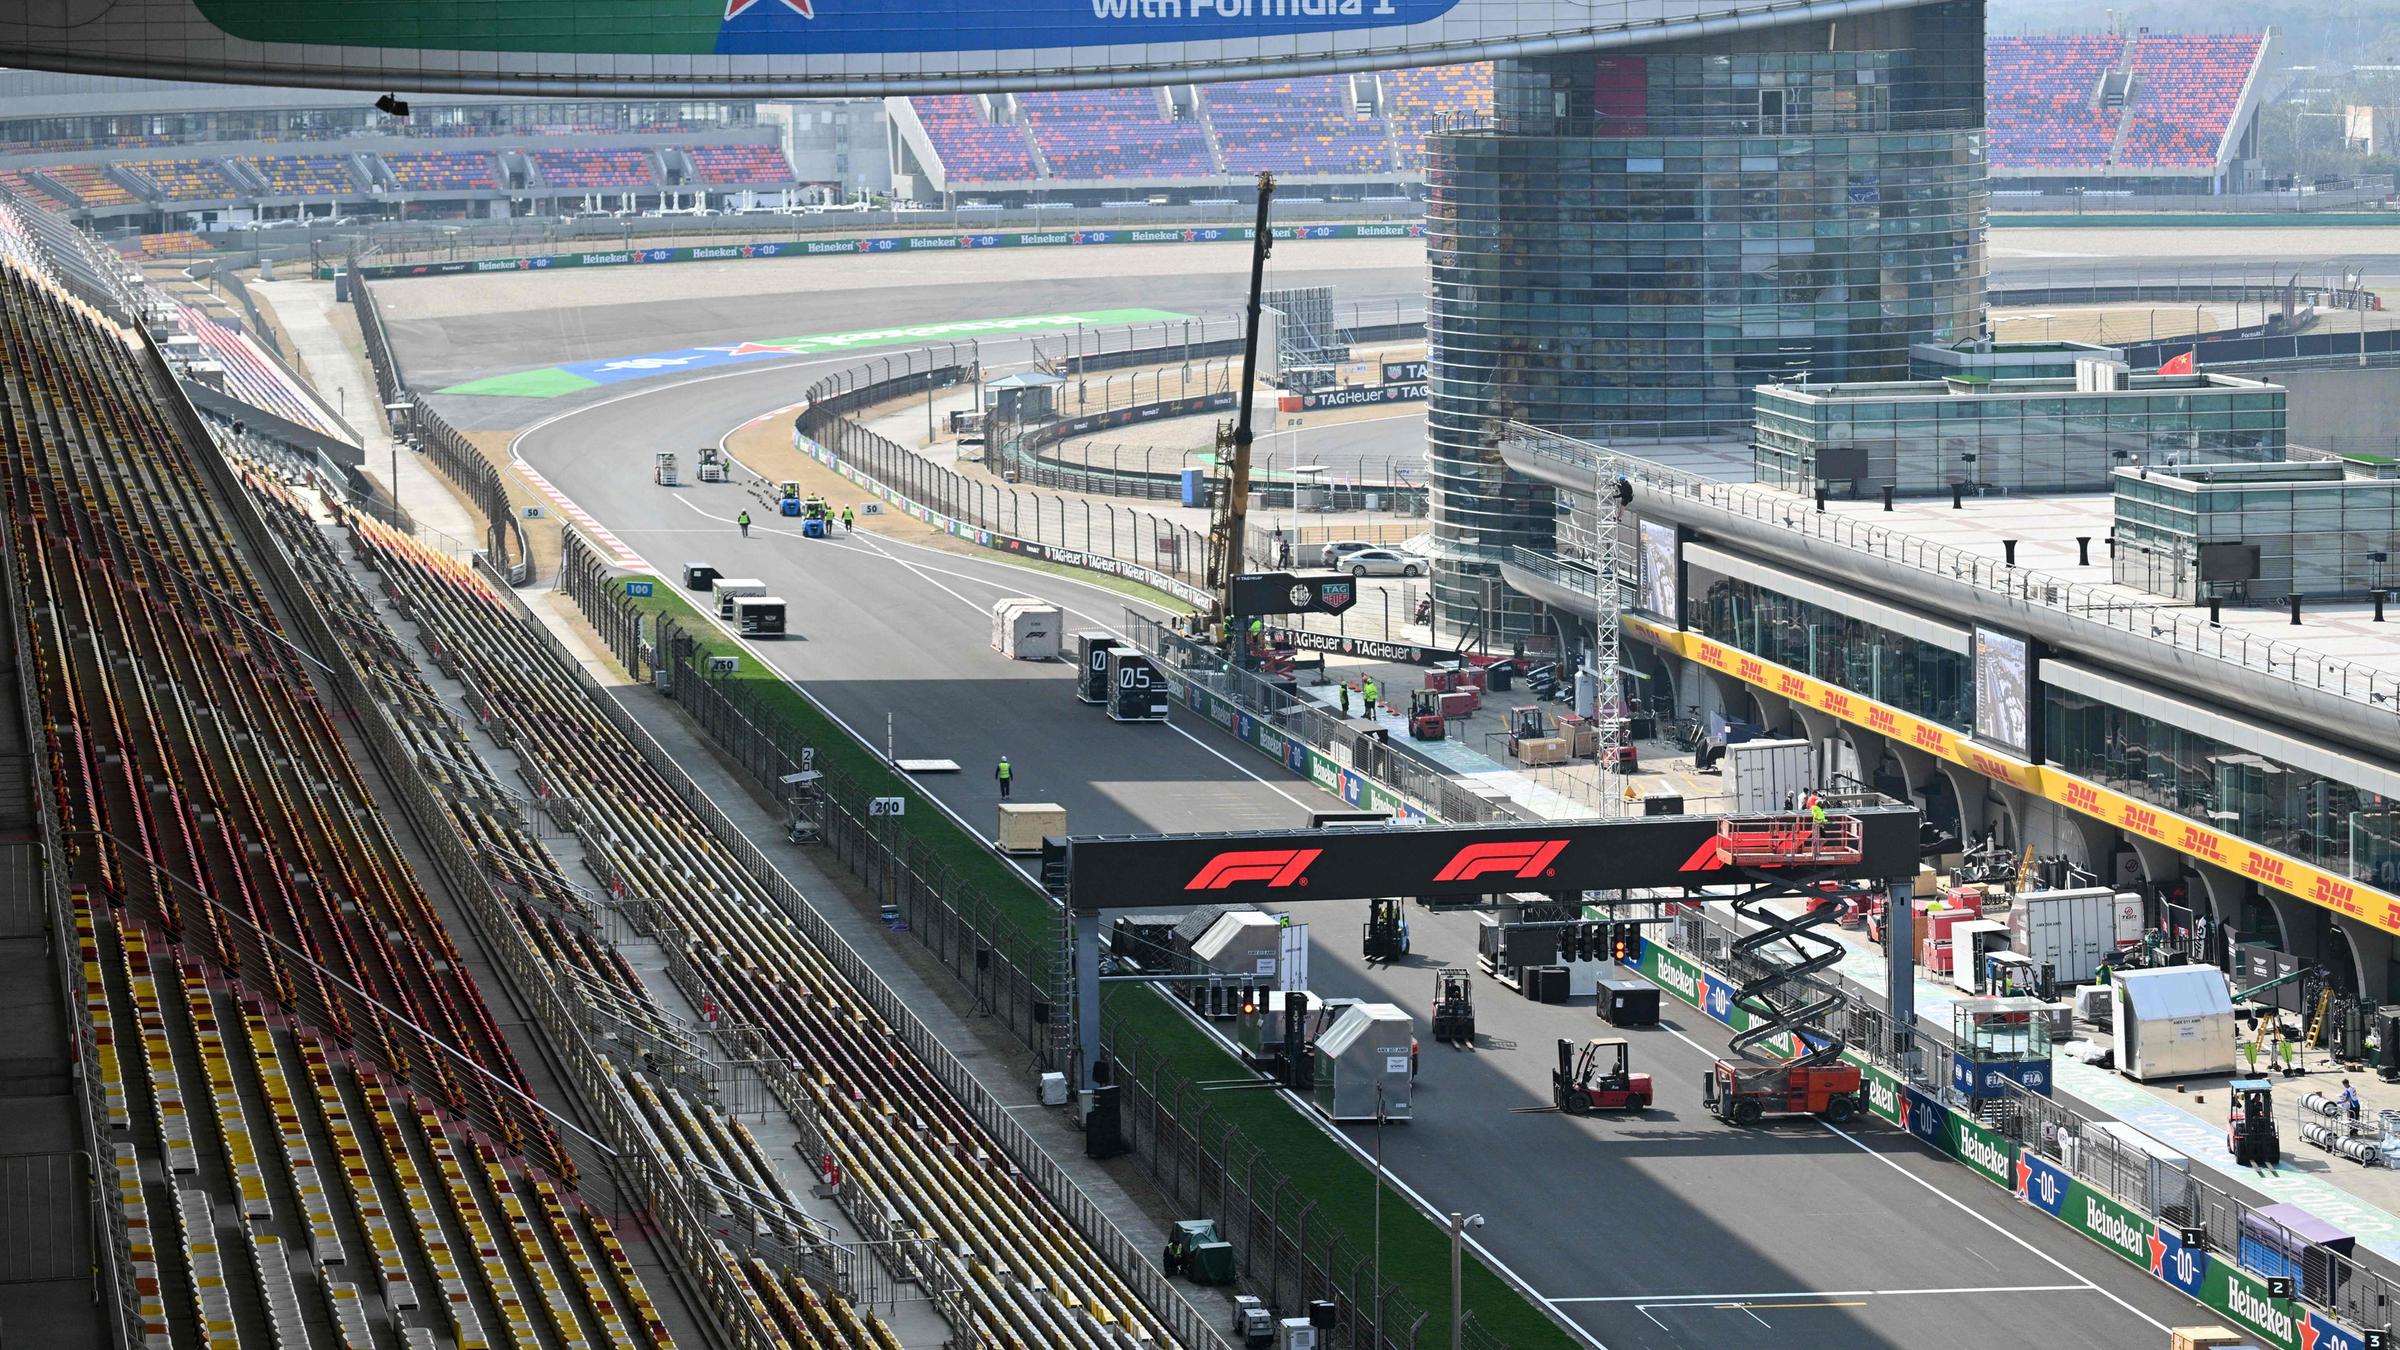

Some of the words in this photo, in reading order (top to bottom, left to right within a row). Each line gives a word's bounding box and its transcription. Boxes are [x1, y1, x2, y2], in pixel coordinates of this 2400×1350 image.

[1132, 230, 1178, 241] Heineken
[1244, 226, 1291, 238] Heken
[1357, 225, 1403, 236] Heineken
[910, 237, 956, 248] Heineken
[1021, 232, 1067, 245] Heineken
[693, 247, 737, 258] Heineken
[808, 242, 854, 253] Heineken
[582, 251, 628, 265] Heineken
[479, 261, 515, 271] Heineken
[527, 508, 539, 517] 50
[866, 504, 878, 514] 50
[630, 584, 649, 595] 100
[1325, 585, 1347, 593] TAG
[1355, 641, 1409, 660] TAGHeuer
[1700, 642, 1725, 668] DHL
[1740, 658, 1764, 684] DHL
[1781, 673, 1806, 700] DHL
[1824, 690, 1850, 717] DHL
[1869, 706, 1896, 734] DHL
[1916, 724, 1944, 753] DHL
[1312, 756, 1337, 789] Heineken
[2067, 782, 2100, 815] DHL
[875, 801, 900, 813] 200
[2124, 804, 2158, 836] DHL
[2184, 826, 2220, 861] DHL
[2248, 850, 2286, 886] DHL
[2316, 876, 2356, 913] DHL
[1657, 953, 1696, 998] Heineken
[1715, 986, 1726, 1016] 0.0
[1987, 1077, 2005, 1085] FIA
[2022, 1073, 2041, 1083] FIA
[1870, 1077, 1894, 1114] eken
[1920, 1102, 1933, 1134] 0.0
[2041, 1170, 2055, 1206] 0.0
[2086, 1195, 2144, 1258] Heineken
[2176, 1247, 2193, 1286] 0.0
[2187, 1233, 2196, 1245] 1
[2273, 1281, 2284, 1294] 2
[2227, 1274, 2293, 1344] Heineken
[2369, 1335, 2380, 1347] 3
